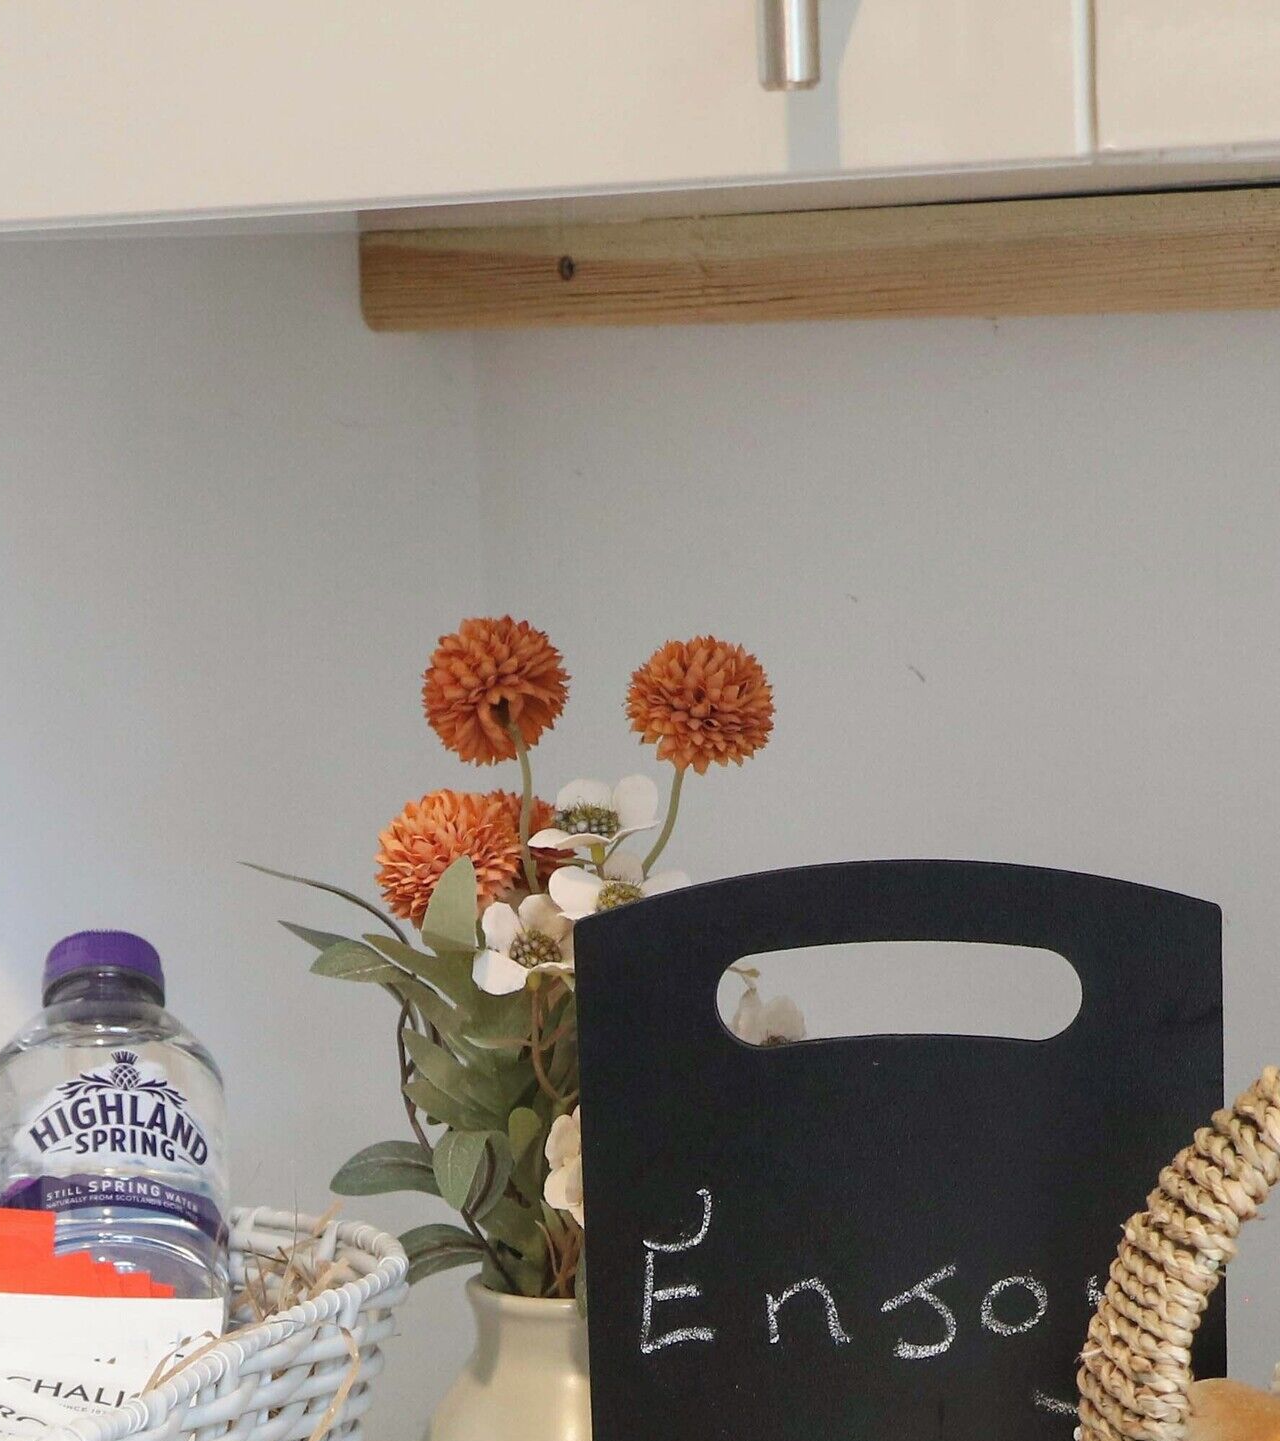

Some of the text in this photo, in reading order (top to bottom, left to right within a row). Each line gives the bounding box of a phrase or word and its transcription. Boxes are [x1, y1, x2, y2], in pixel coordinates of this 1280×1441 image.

[28, 1093, 209, 1166] HIGHLAND
[75, 1128, 175, 1162] SPRING
[46, 1186, 82, 1201] STILL
[88, 1180, 161, 1197] SPRING
